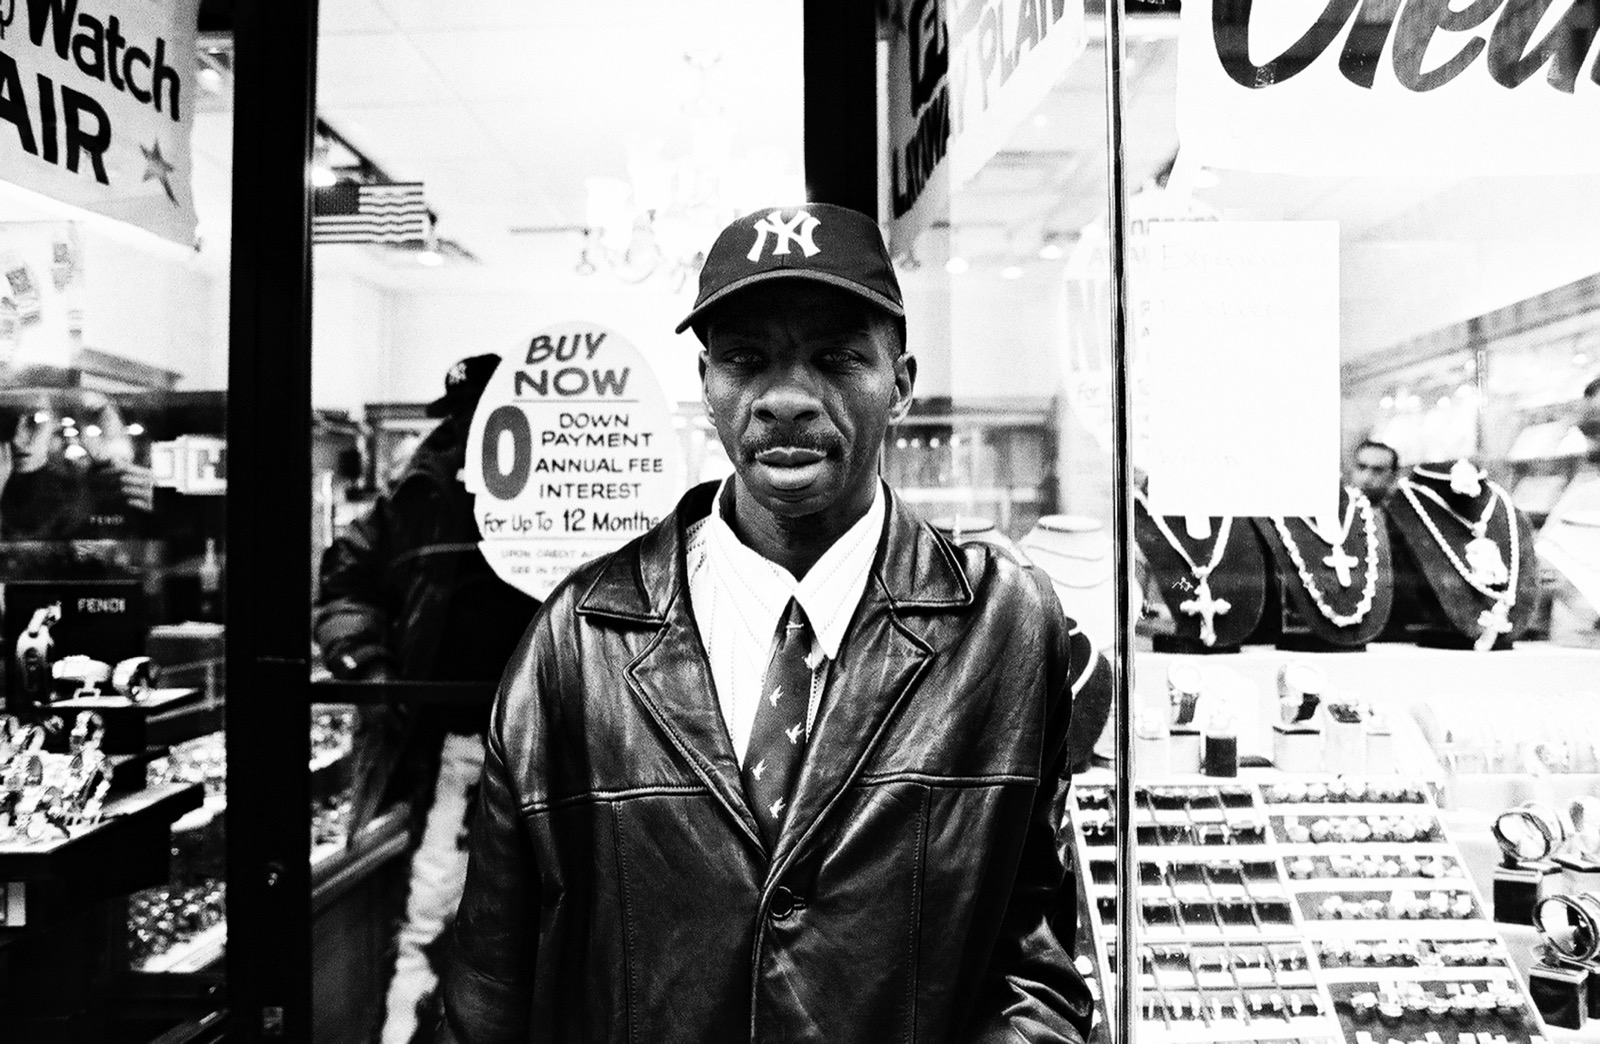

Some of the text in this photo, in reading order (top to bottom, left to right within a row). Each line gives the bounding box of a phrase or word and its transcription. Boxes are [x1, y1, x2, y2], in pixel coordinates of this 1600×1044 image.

[26, 0, 181, 122] Watch
[0, 52, 110, 186] AIR
[747, 210, 822, 263] NY
[525, 332, 607, 365] BUY
[514, 367, 631, 397] NOW
[559, 412, 630, 429] DOWN
[481, 404, 532, 501] 0
[541, 430, 654, 448] PAYMENT
[535, 458, 663, 474] ANNUAL FEE
[539, 483, 642, 500] INTEREST
[484, 508, 660, 534] For Up To 12 Months
